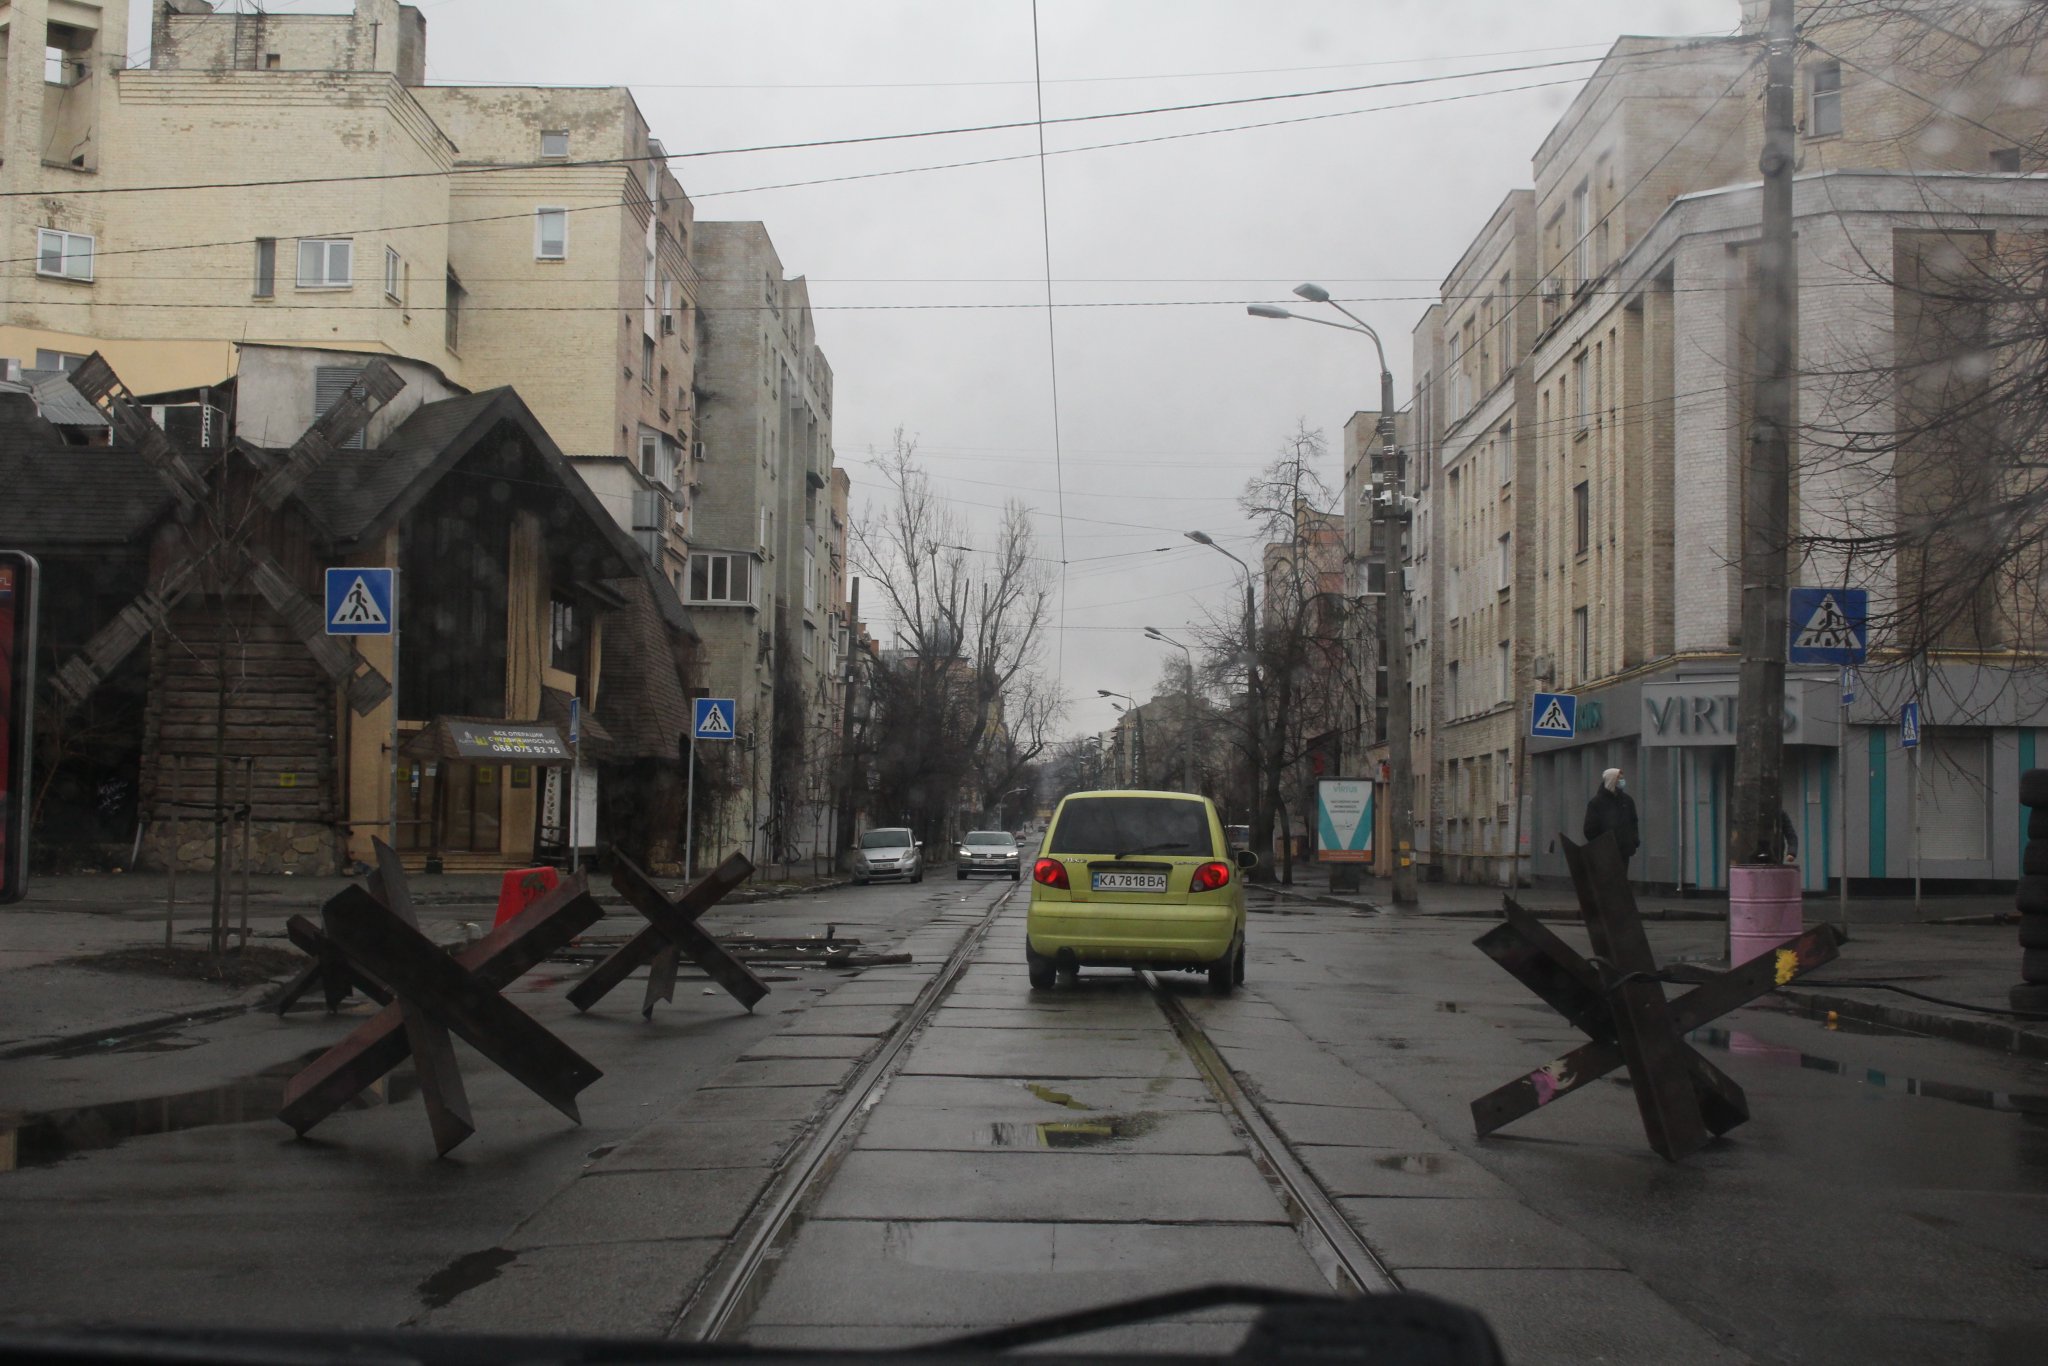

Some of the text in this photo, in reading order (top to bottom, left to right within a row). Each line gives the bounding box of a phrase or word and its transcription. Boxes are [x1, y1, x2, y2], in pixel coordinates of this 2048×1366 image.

[1645, 695, 1797, 735] VIRTS
[492, 744, 561, 754] 068 075 92 76
[1099, 875, 1165, 887] KA 7818 BA
